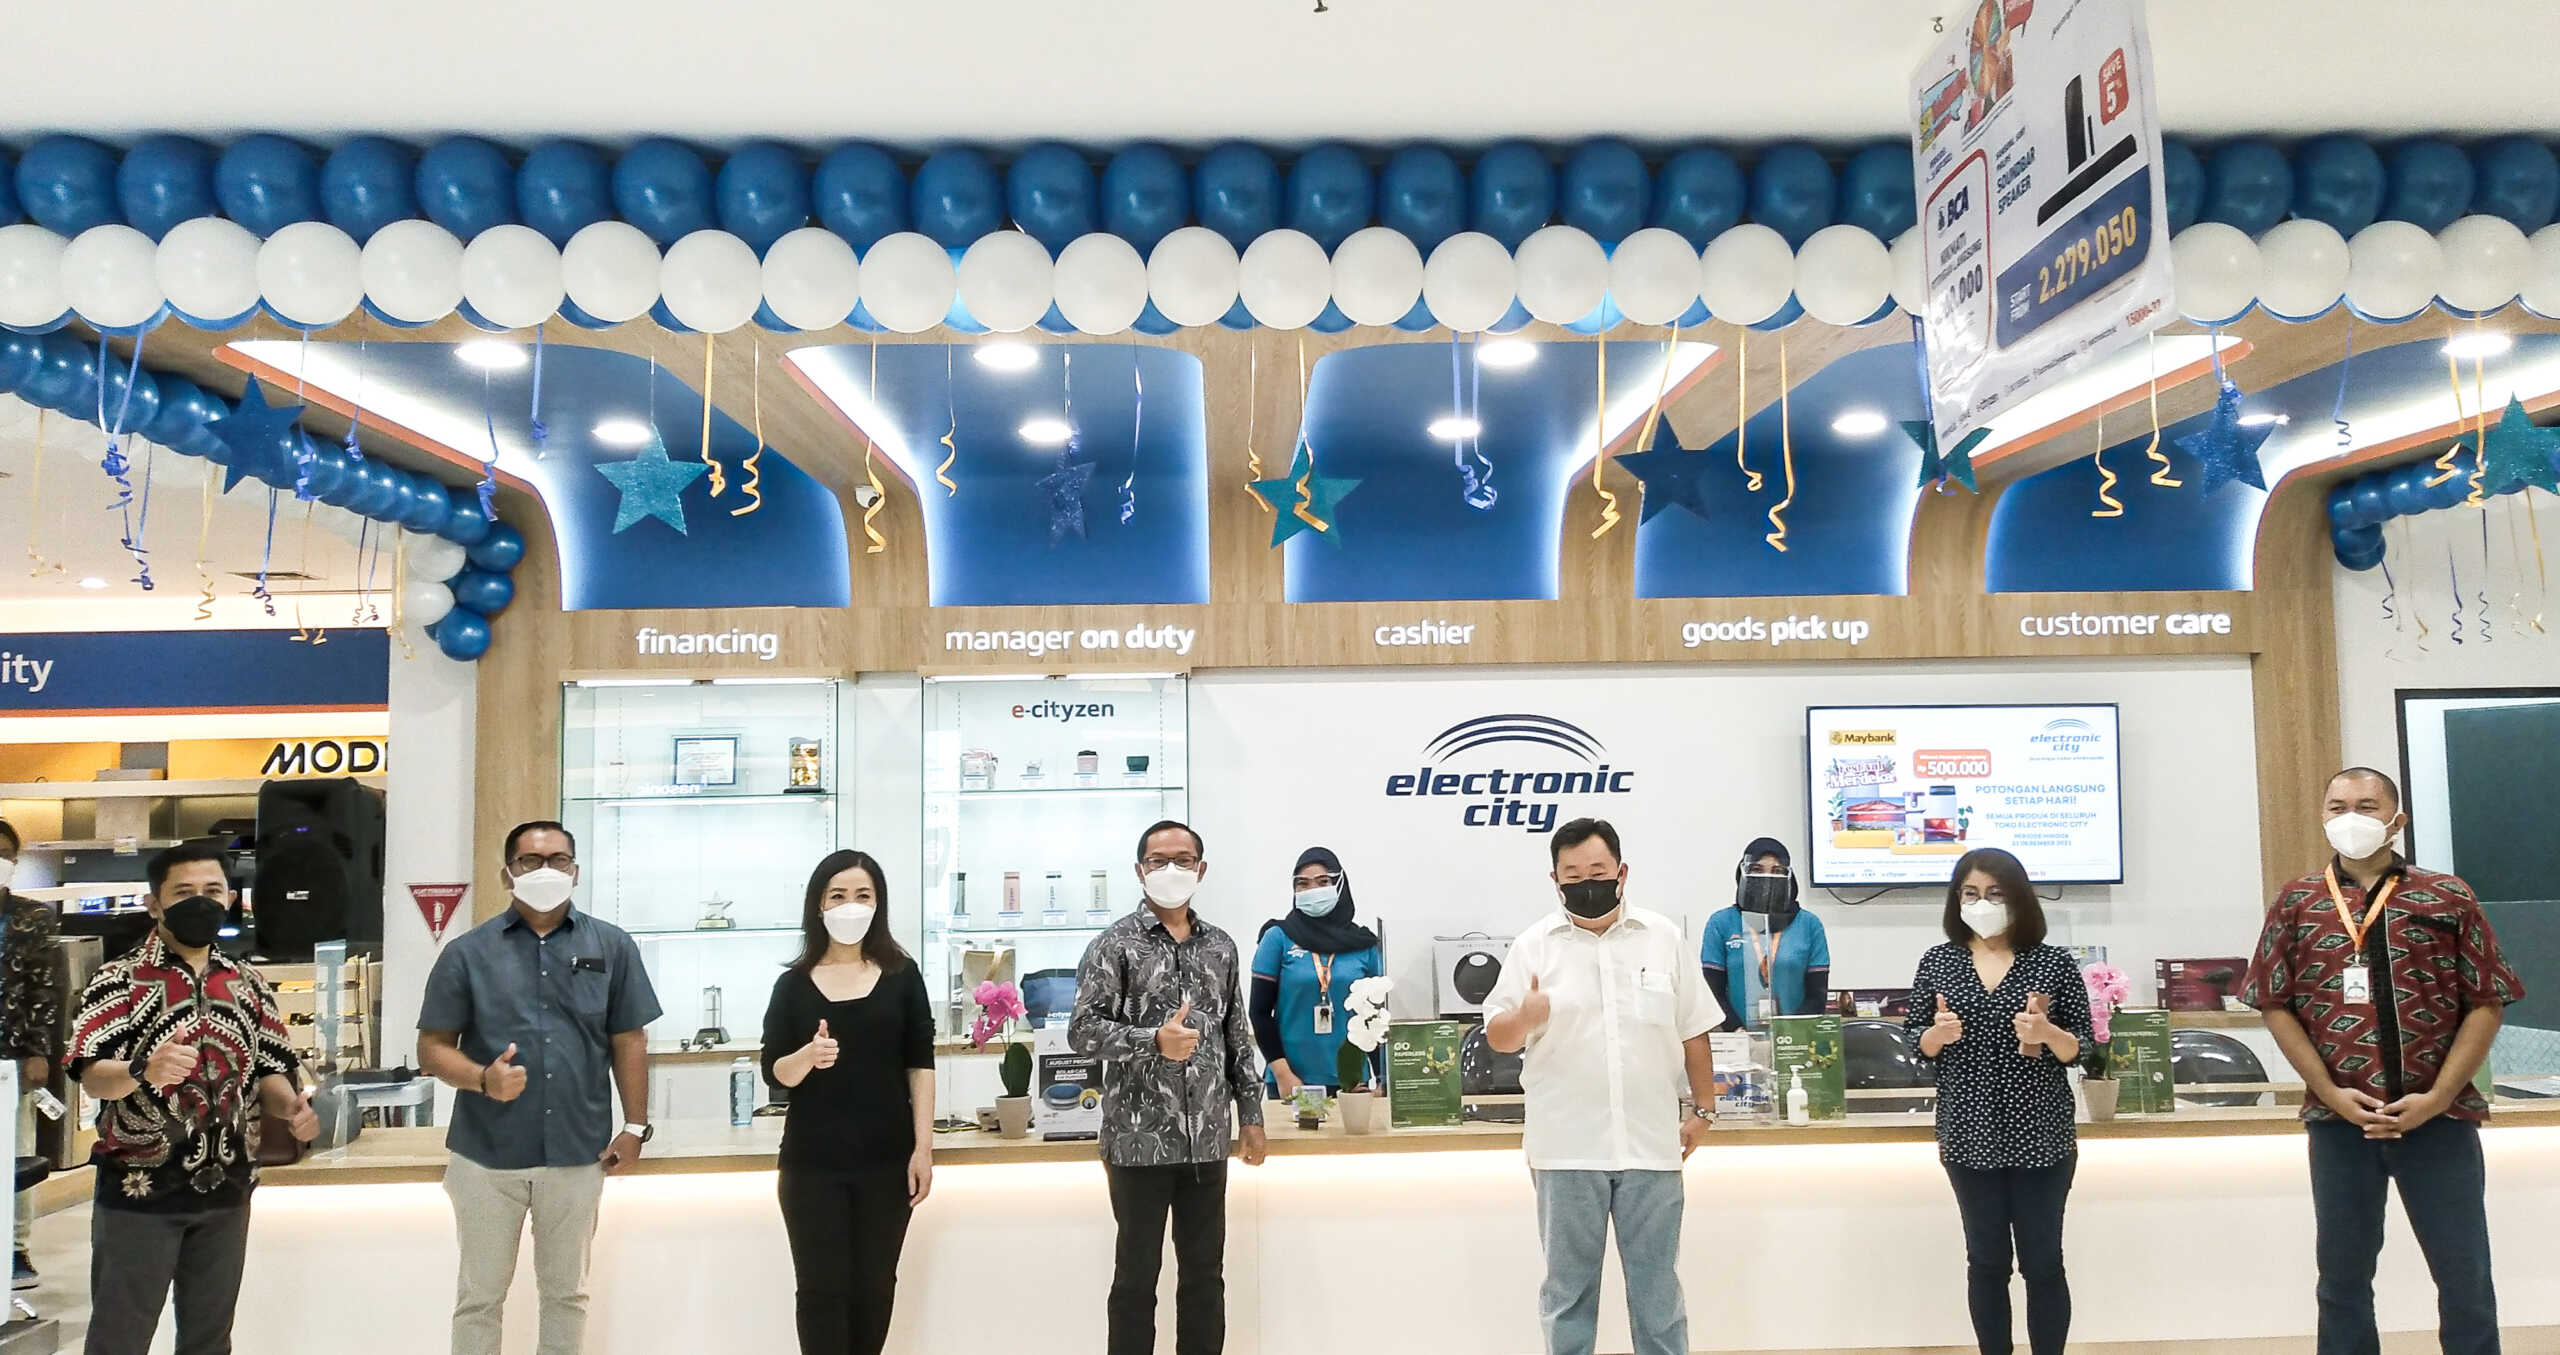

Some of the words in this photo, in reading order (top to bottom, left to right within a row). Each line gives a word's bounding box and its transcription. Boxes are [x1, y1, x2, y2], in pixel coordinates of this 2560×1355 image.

[1997, 146, 2036, 193] SOUNDBAR
[1947, 185, 1969, 228] BCA
[1998, 174, 2032, 215] SPEAKER
[2038, 206, 2137, 304] 2.279.050
[1375, 620, 1474, 645] cashier
[1682, 615, 1766, 648] goods
[1771, 615, 1827, 647] pick
[1832, 619, 1870, 645] up
[2020, 612, 2160, 636] customer
[2165, 613, 2231, 634] care
[636, 628, 779, 661] financing
[945, 629, 1076, 656] manager
[1080, 629, 1120, 649] on
[1125, 623, 1196, 656] duty
[1011, 700, 1115, 722] e-cityzen
[1844, 732, 1895, 745] Maybank
[2030, 733, 2102, 743] electronic
[2052, 743, 2081, 753] city
[260, 740, 388, 775] MOD
[1927, 760, 1990, 776] 500.000
[1385, 764, 1635, 797] electronic
[1975, 785, 2040, 794] POTONGAN
[2041, 784, 2106, 793] LANGSUNG
[2004, 796, 2044, 805] SETIAP
[1463, 797, 1559, 833] city
[1393, 1041, 1411, 1051] GO
[1776, 1035, 1793, 1044] GO
